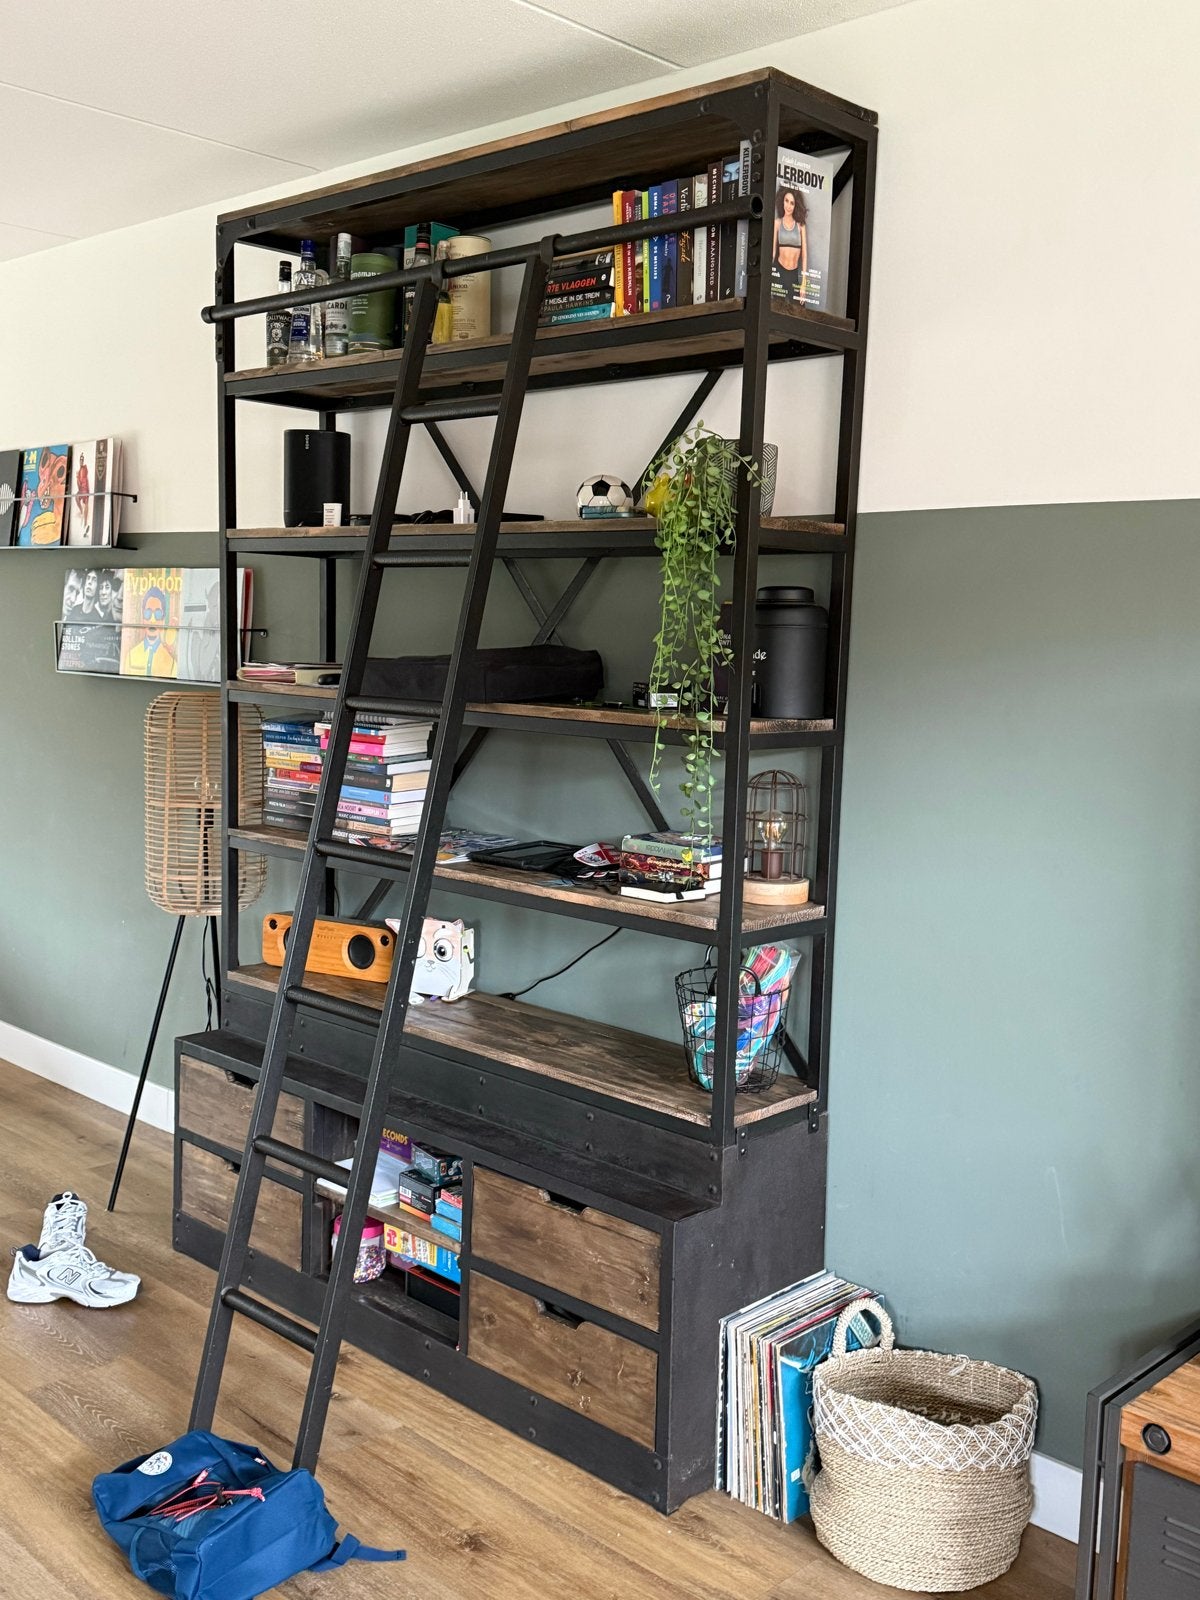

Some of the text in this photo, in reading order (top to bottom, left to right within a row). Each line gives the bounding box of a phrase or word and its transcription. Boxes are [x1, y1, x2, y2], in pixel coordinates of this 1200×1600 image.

[742, 147, 750, 196] KILLERBODY
[778, 163, 824, 190] LERBODY
[561, 277, 597, 290] VLAGGEN
[124, 573, 183, 595] Typhoon
[61, 643, 80, 651] STONES
[382, 1127, 408, 1146] ECONDS
